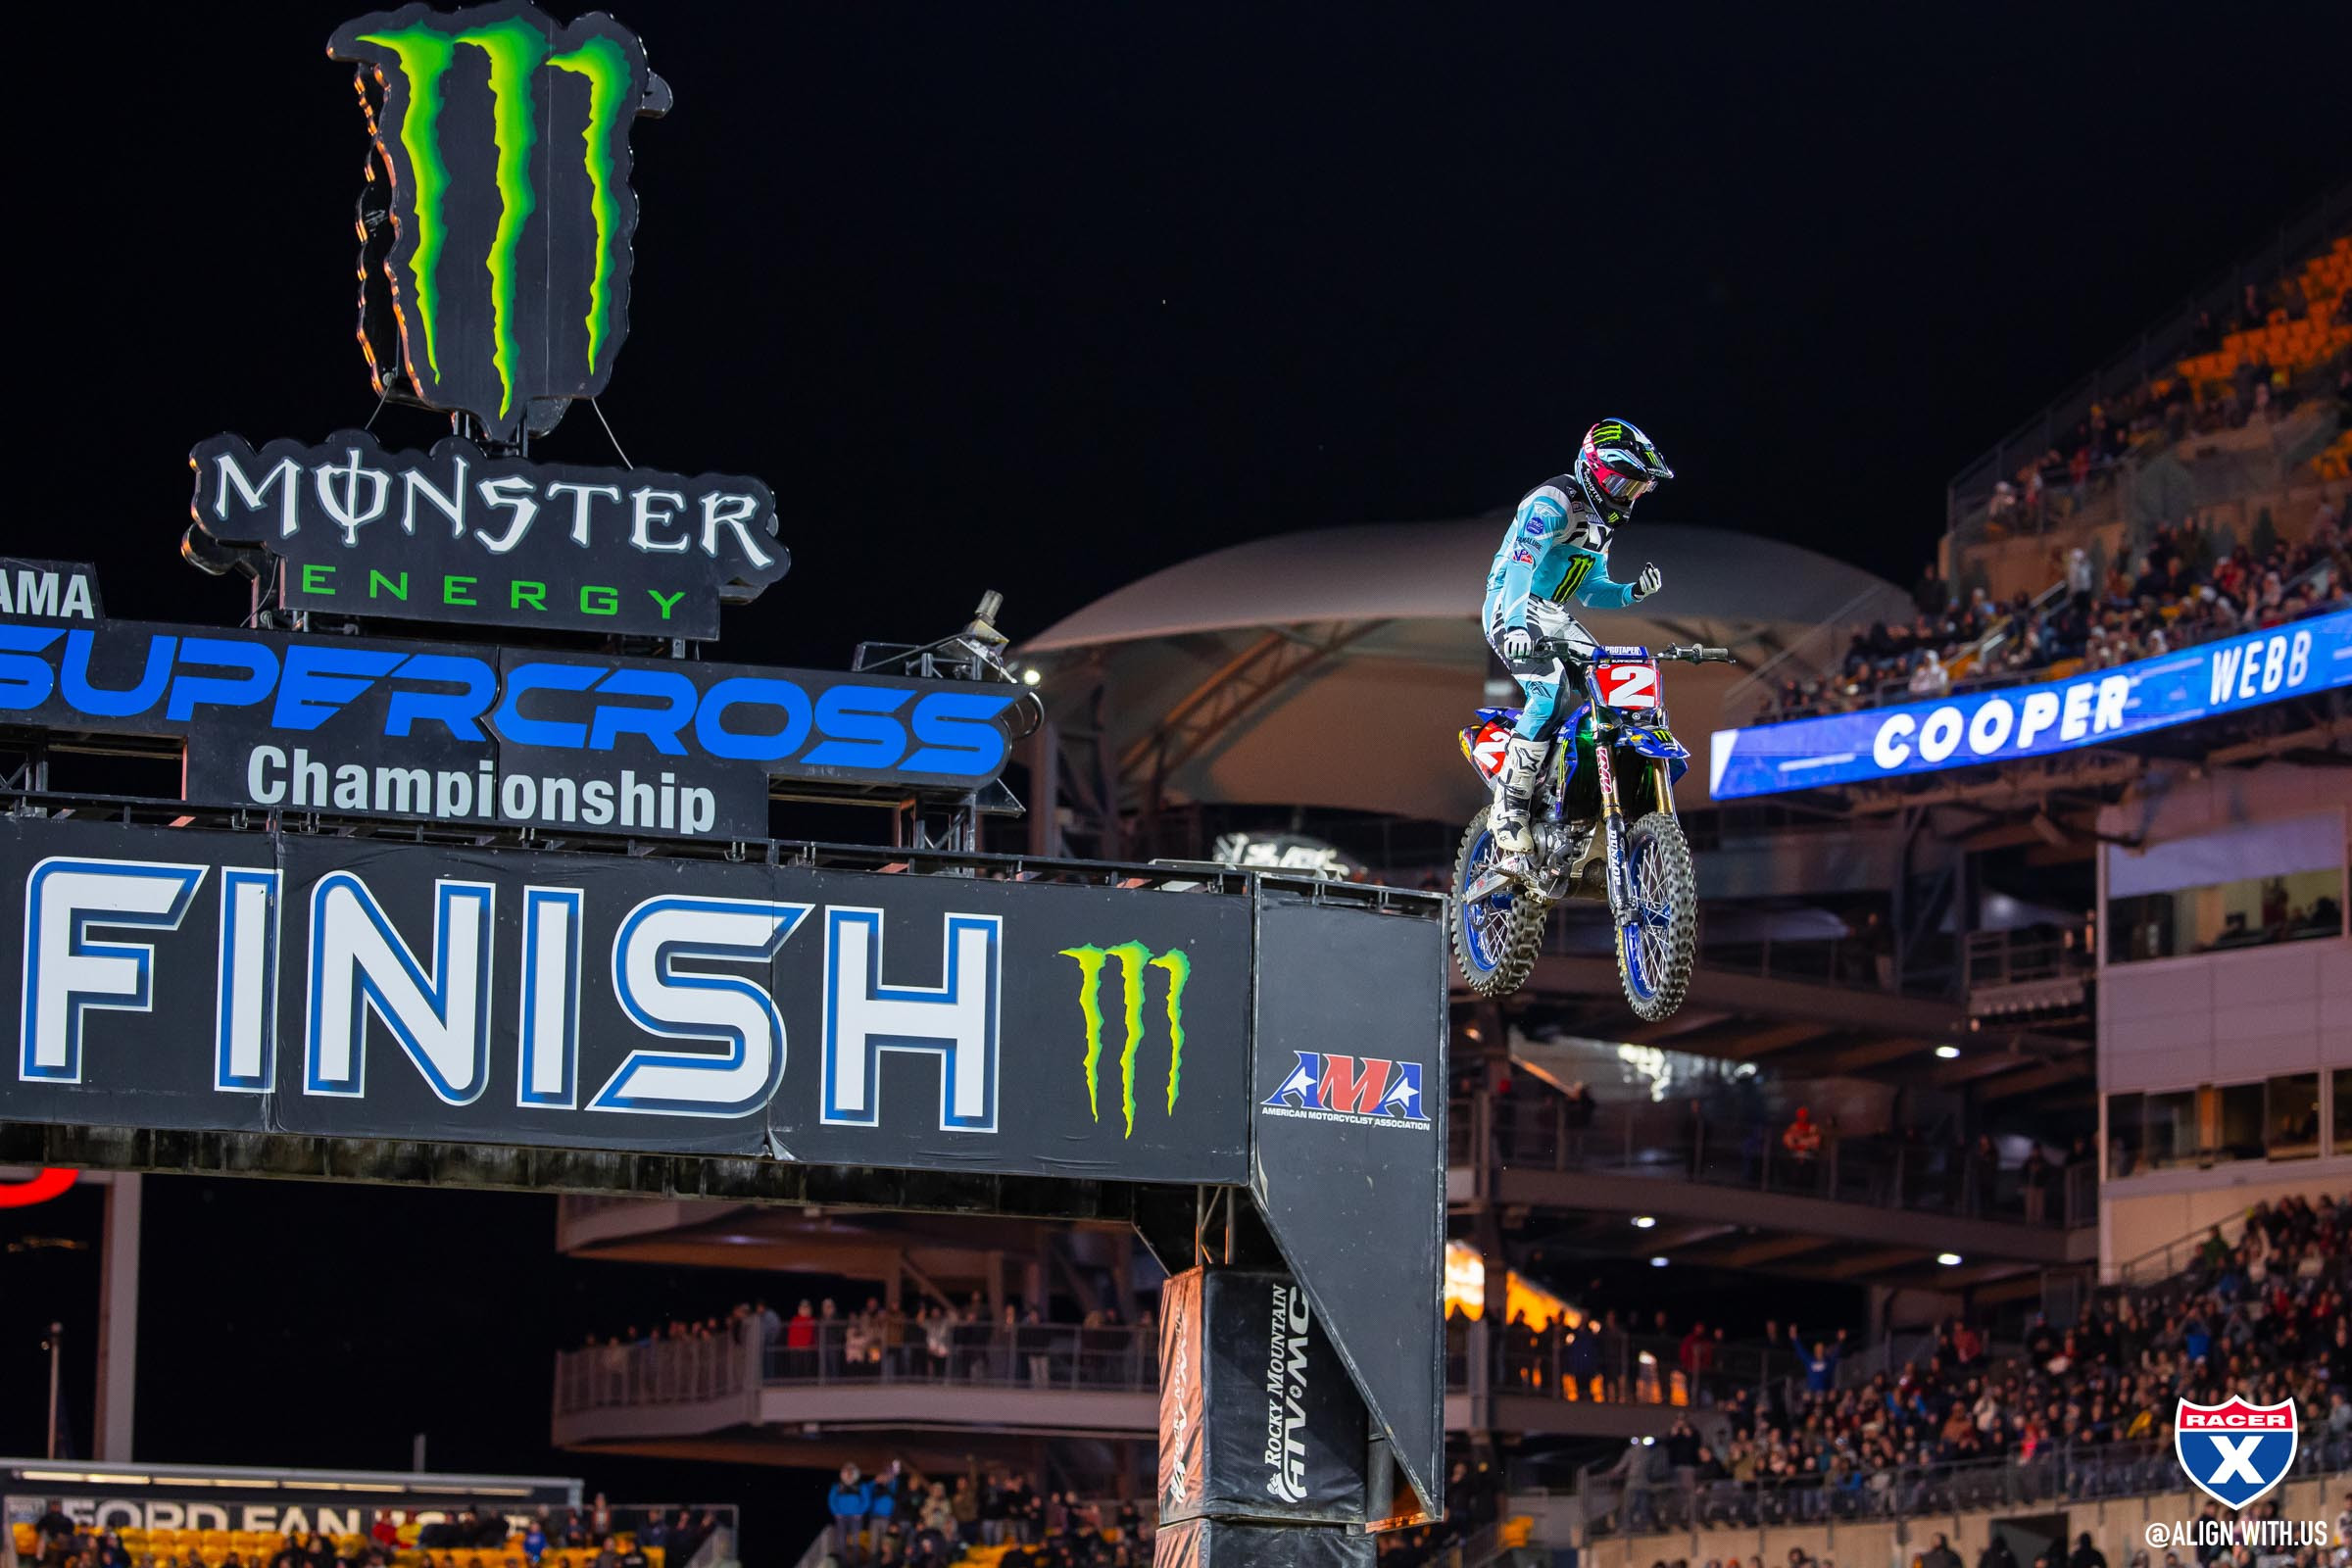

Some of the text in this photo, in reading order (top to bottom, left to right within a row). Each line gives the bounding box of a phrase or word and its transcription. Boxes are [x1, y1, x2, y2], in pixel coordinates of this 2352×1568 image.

[214, 447, 774, 569] MONSTER
[303, 564, 687, 620] ENERGY
[1605, 646, 1640, 656] PROTAPER
[1608, 665, 1656, 708] 2
[0, 623, 1014, 776] SUPERCROSS
[1873, 629, 2313, 769] COOPER WEBB
[1473, 731, 1511, 769] 2
[247, 745, 716, 836] Championship
[1609, 829, 1621, 886] DUNLOP
[19, 856, 1003, 1135] FINISH
[1260, 1050, 1432, 1121] AMA
[1261, 1106, 1431, 1131] AMERICAN MOTORCYCLIST ASSOCIATION
[1264, 1284, 1288, 1466] ROCKY MOUNTAIN
